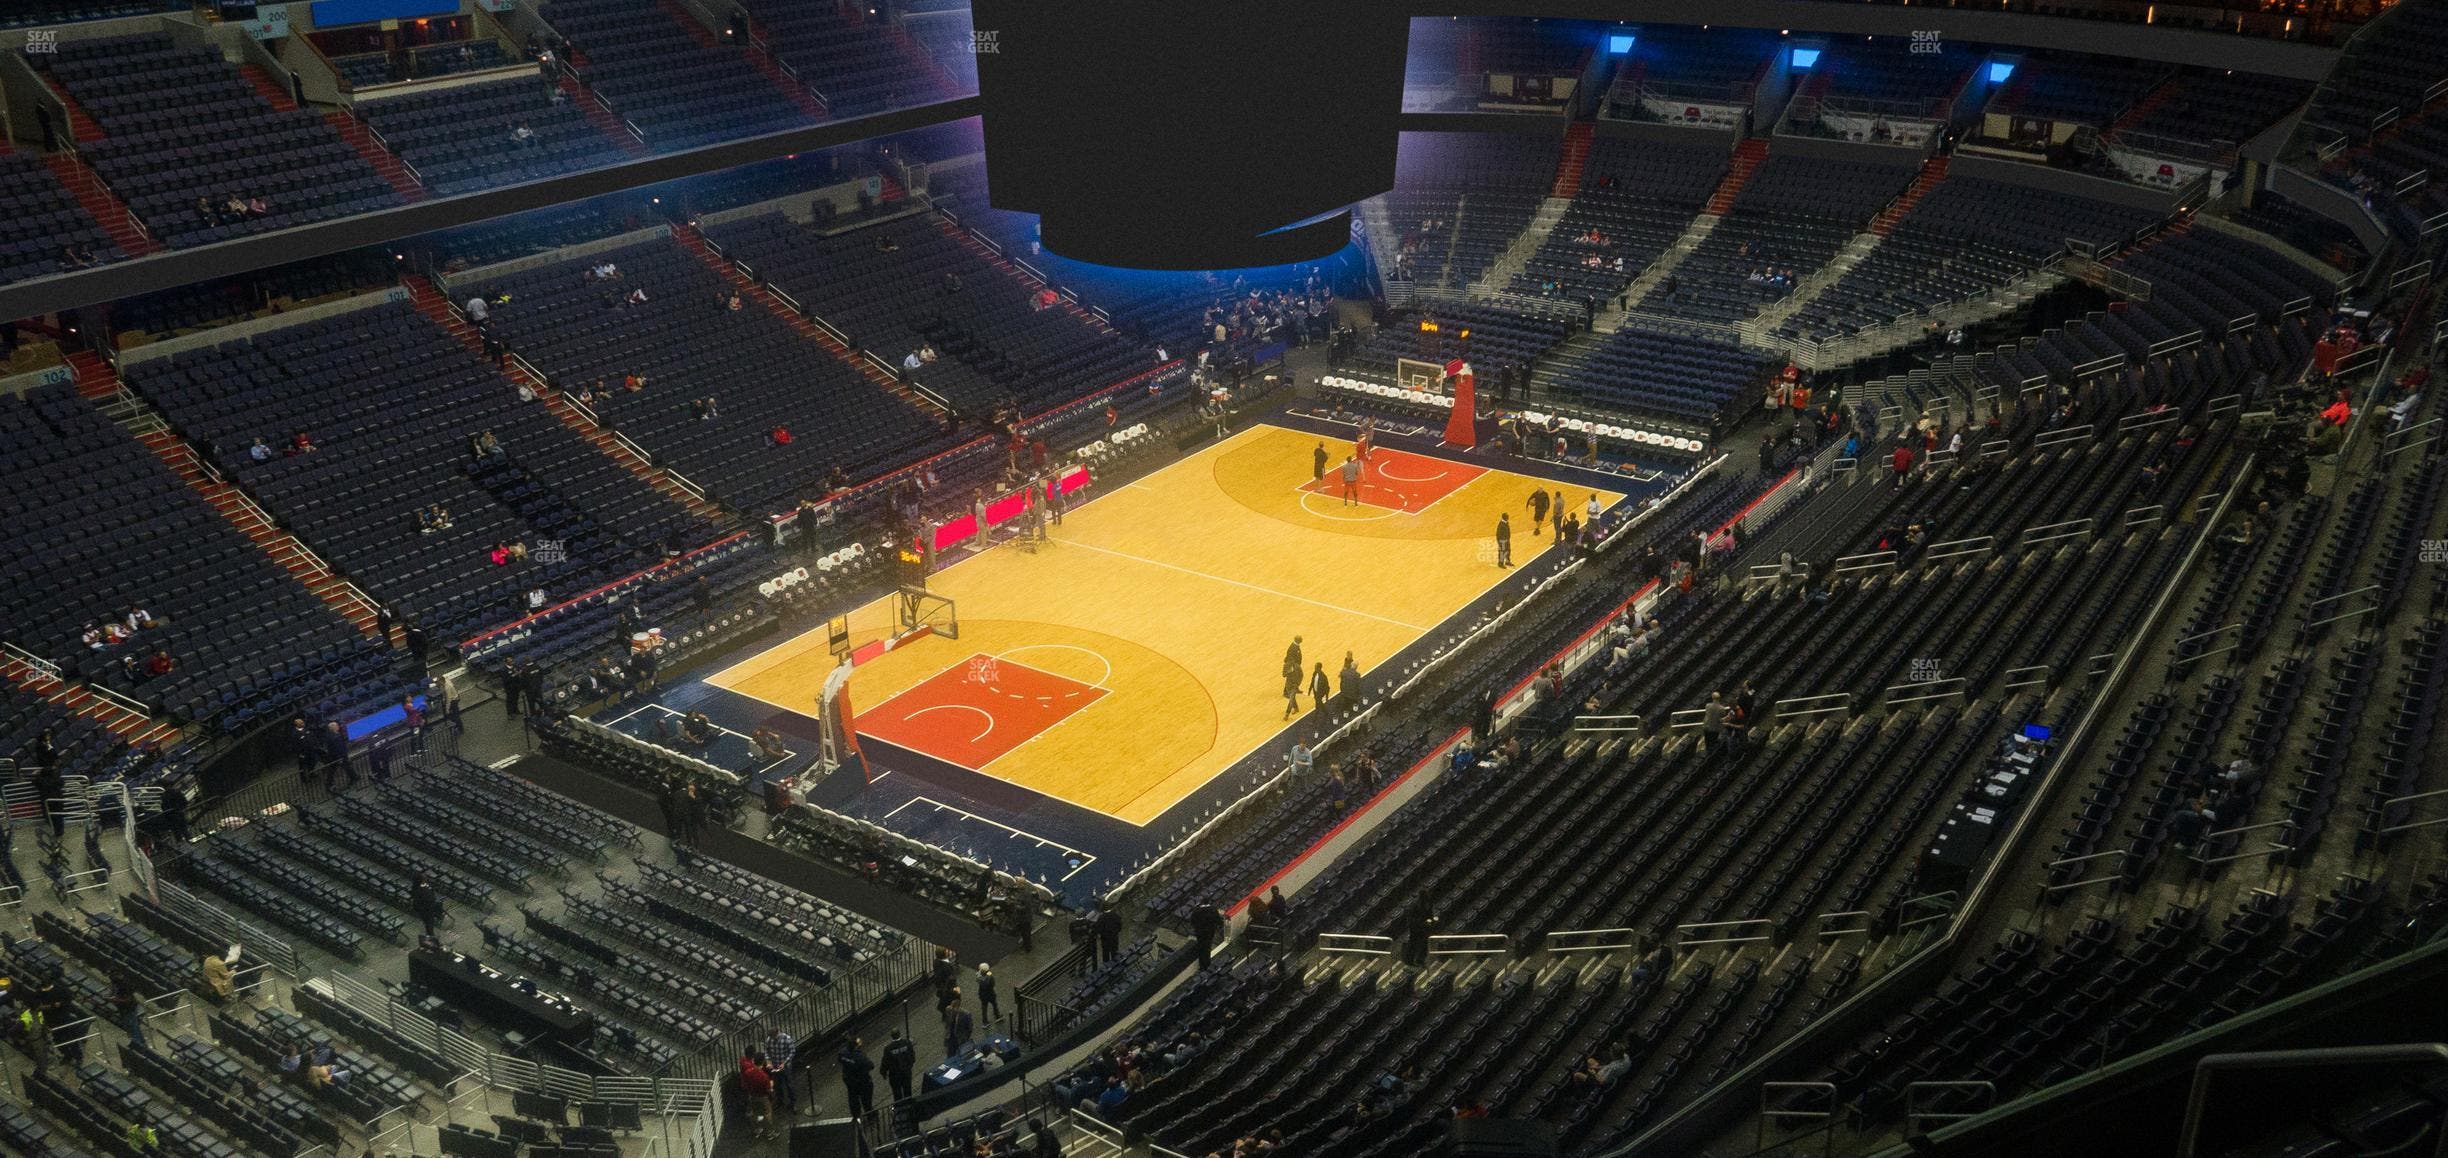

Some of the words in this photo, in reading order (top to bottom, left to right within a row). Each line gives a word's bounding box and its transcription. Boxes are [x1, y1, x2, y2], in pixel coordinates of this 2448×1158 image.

[268, 11, 287, 22] 200
[389, 291, 406, 303] 101
[44, 370, 67, 385] 102
